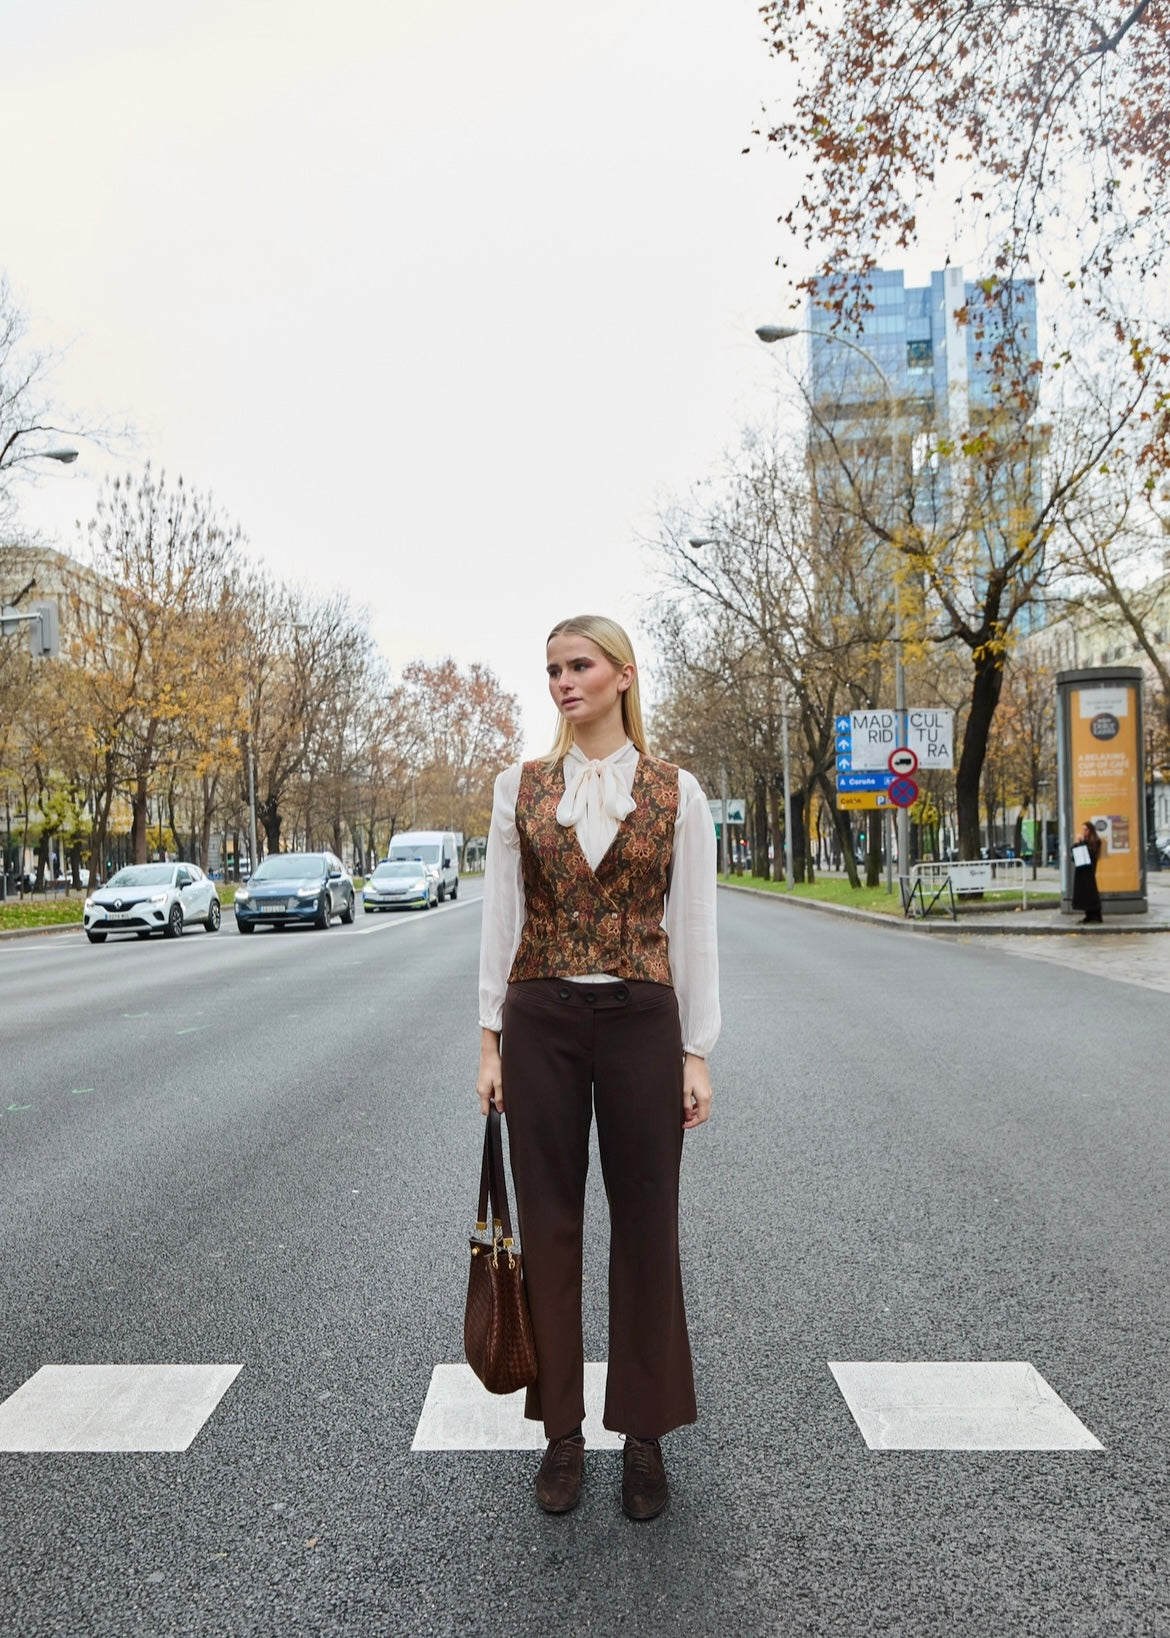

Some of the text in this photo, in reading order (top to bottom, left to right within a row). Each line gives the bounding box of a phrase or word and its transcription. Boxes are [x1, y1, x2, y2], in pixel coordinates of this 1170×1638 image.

[853, 714, 893, 729] MAD
[868, 730, 894, 743] RID
[849, 778, 876, 786] Coruña
